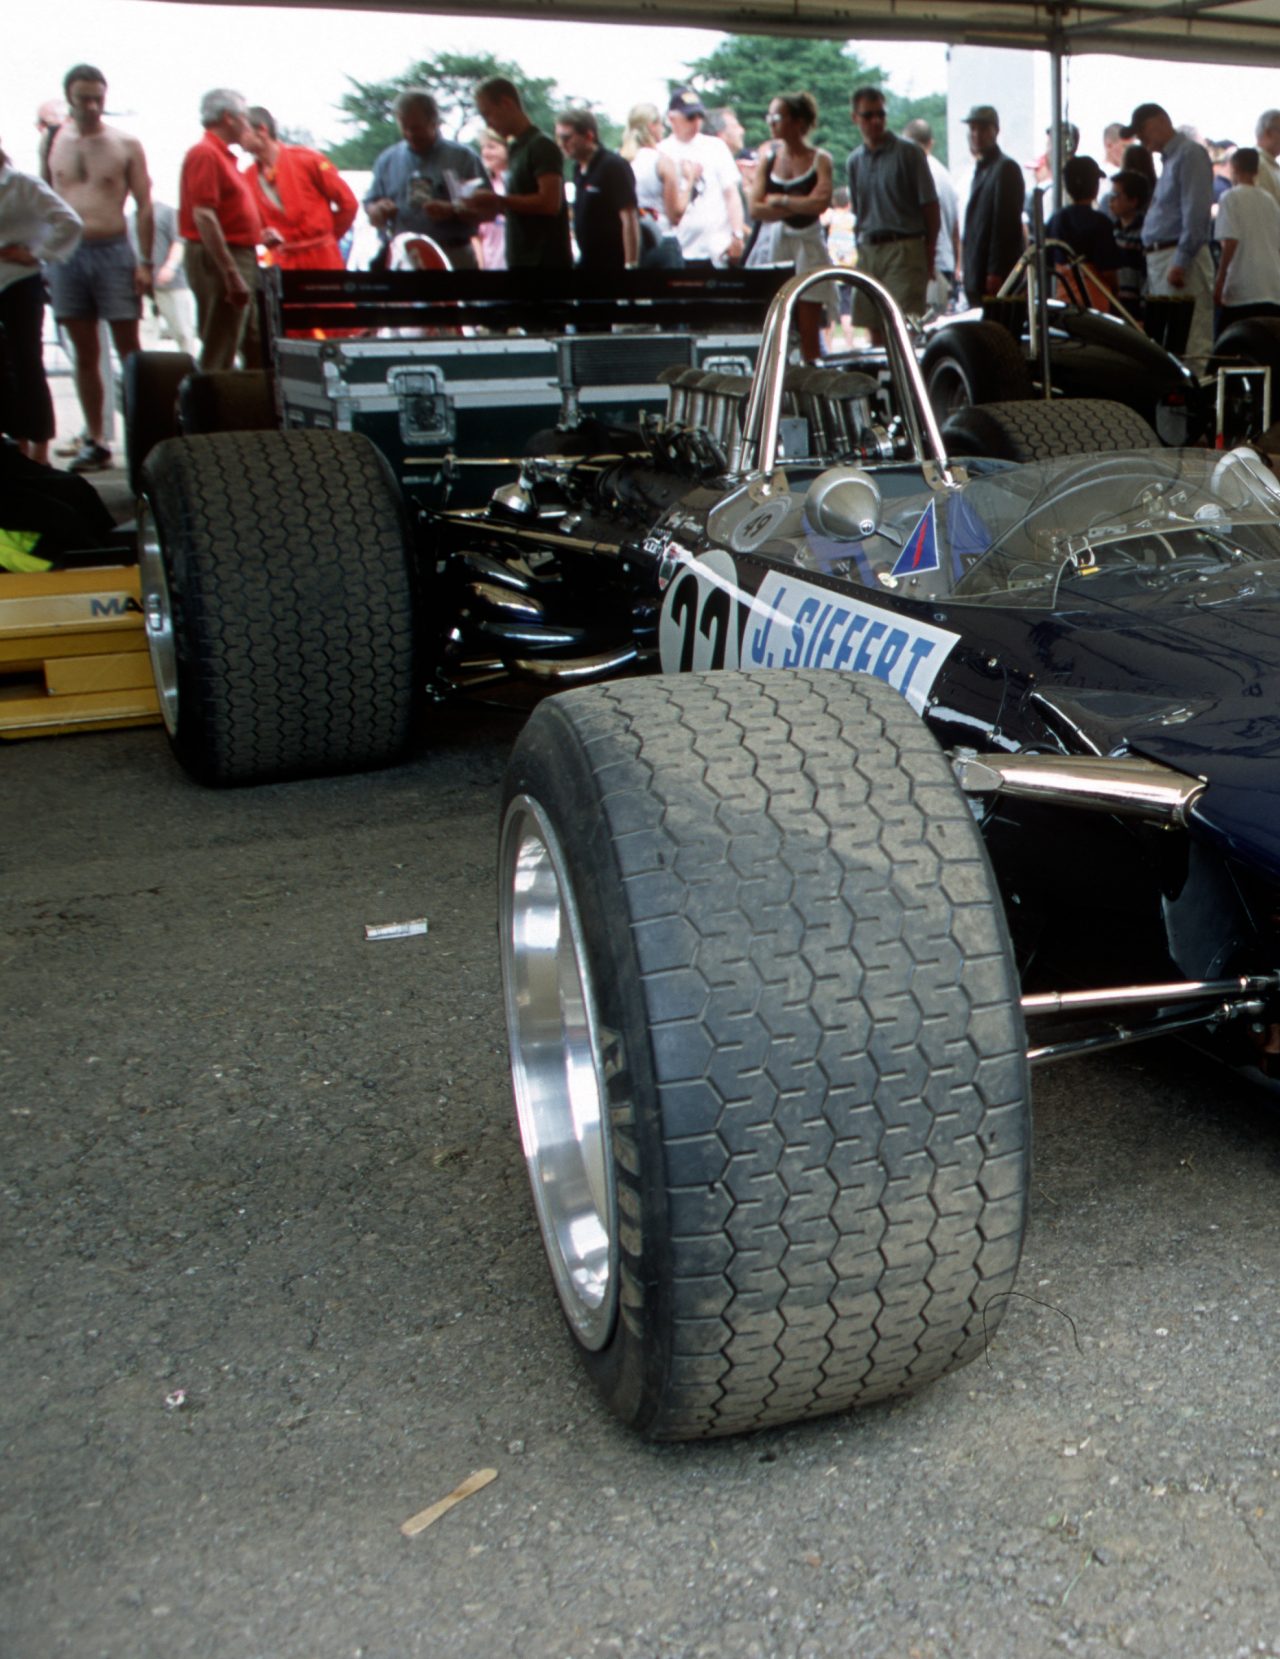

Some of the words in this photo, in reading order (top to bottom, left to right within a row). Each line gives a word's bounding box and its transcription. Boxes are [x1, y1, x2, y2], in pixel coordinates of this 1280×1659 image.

[743, 512, 772, 537] 49
[670, 573, 731, 672] 22
[783, 596, 937, 702] SIFFERT
